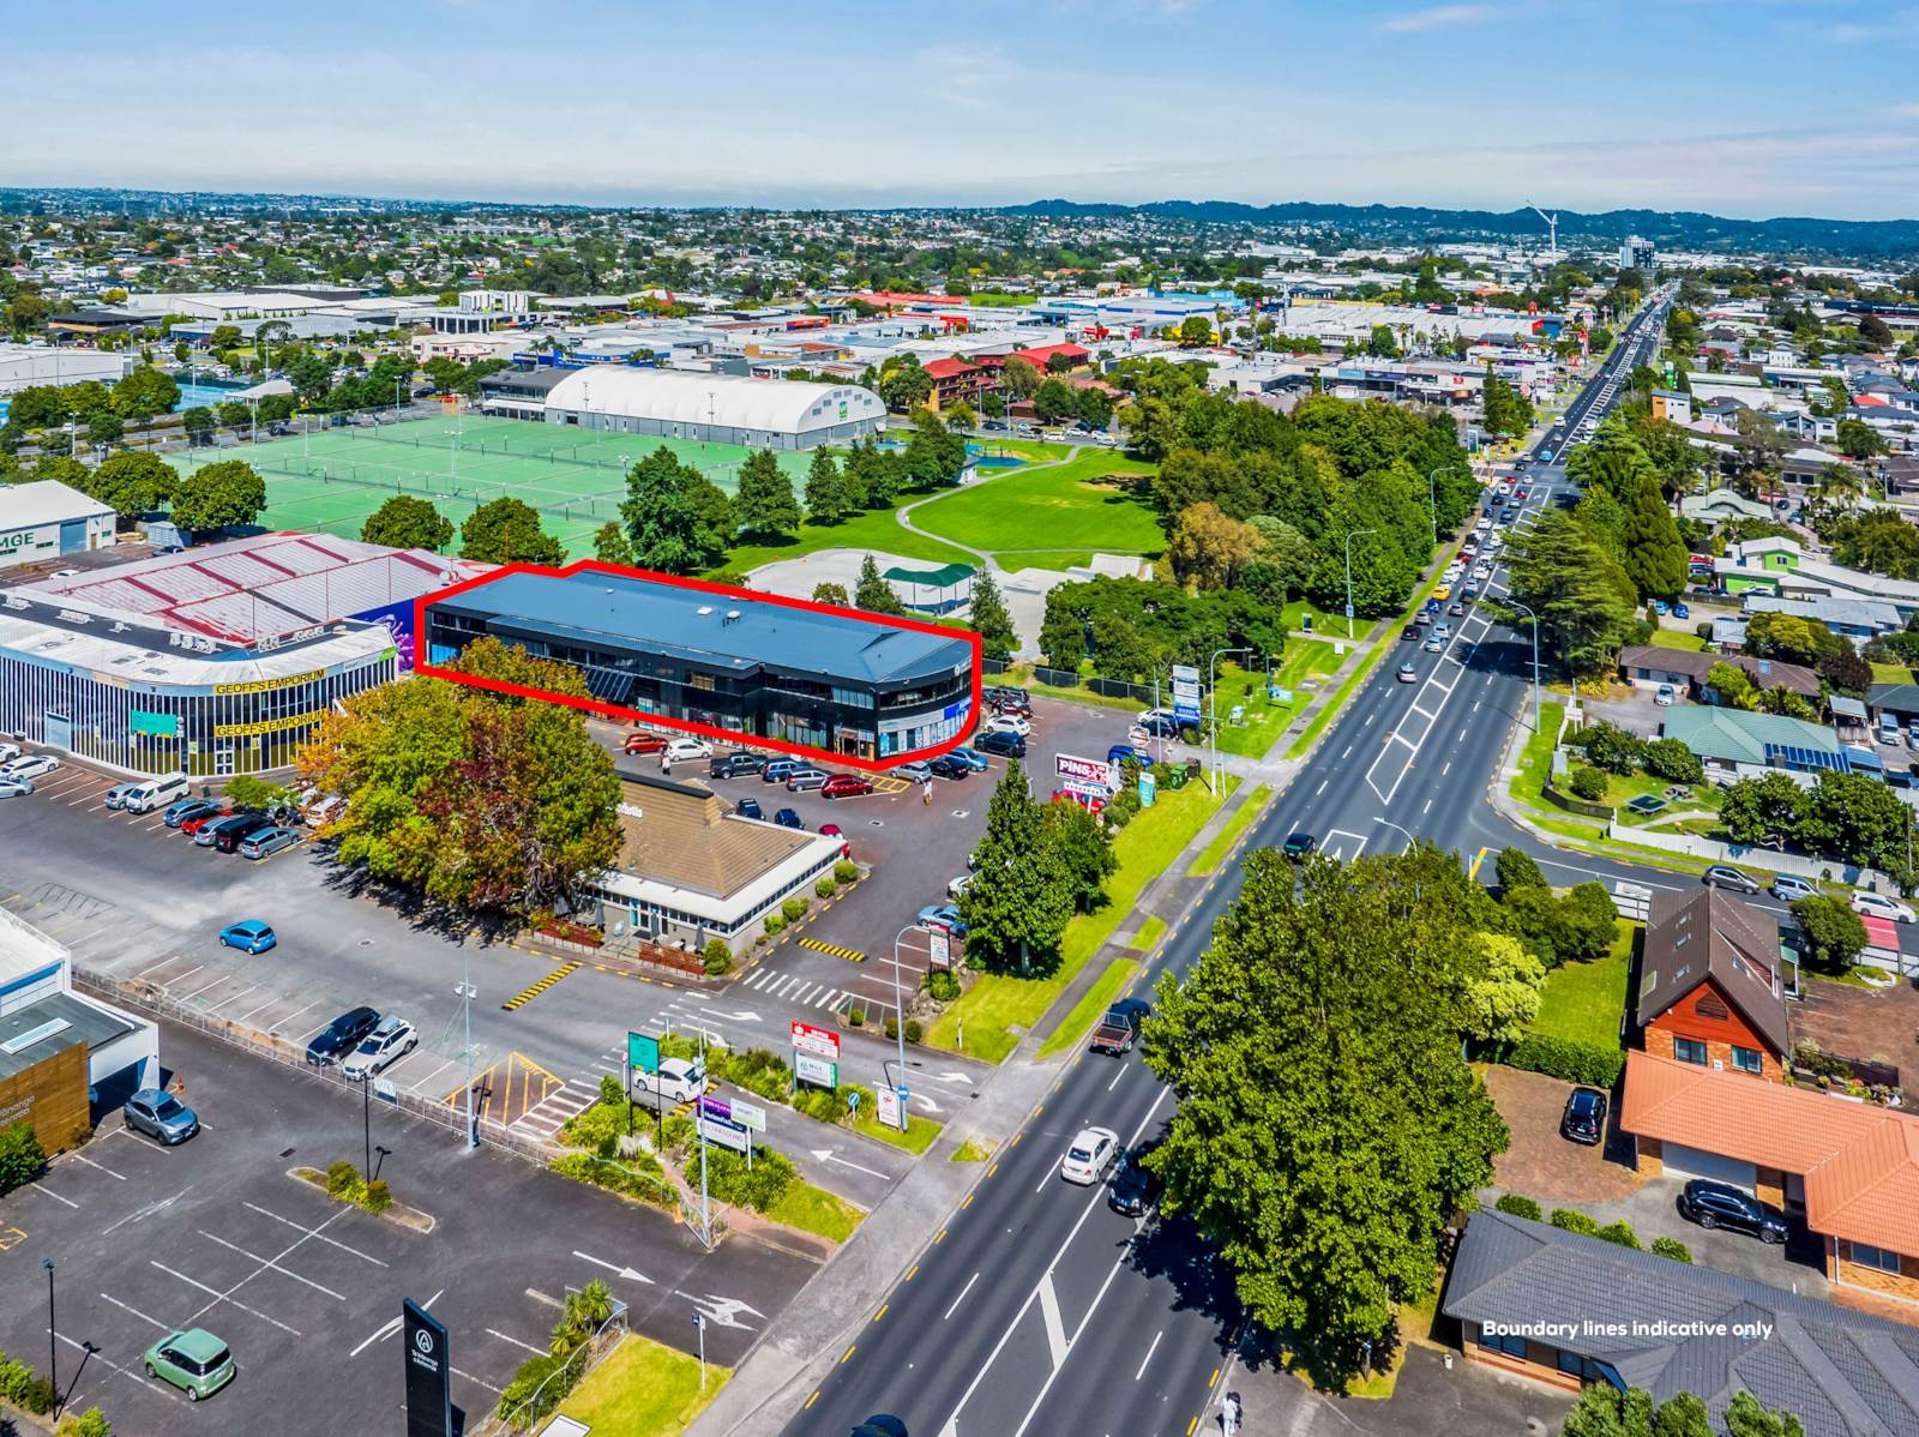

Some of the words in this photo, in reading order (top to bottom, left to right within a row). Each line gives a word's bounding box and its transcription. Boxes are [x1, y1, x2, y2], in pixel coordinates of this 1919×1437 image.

[216, 682, 266, 694] GEOFF'S
[269, 669, 325, 688] EMPORIUM
[216, 723, 266, 736] GEOFF'S
